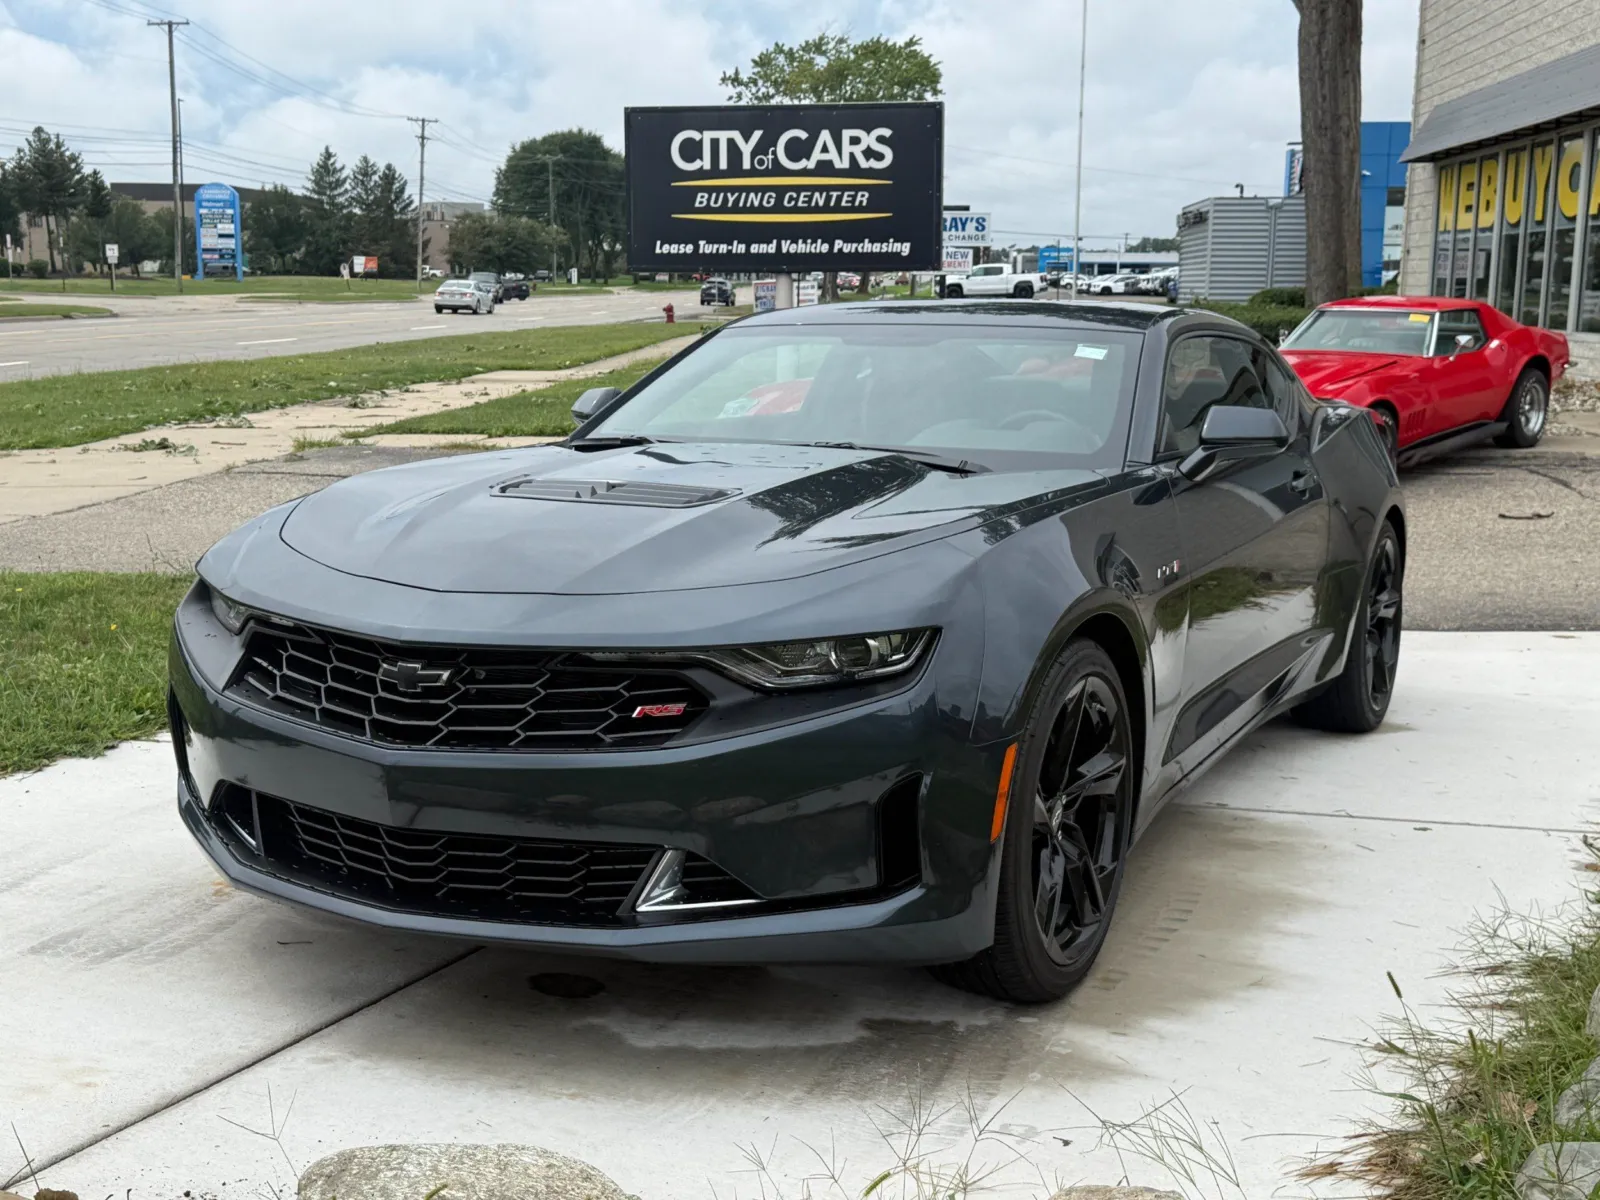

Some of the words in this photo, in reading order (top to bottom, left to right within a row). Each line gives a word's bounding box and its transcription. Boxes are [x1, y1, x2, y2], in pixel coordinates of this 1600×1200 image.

[670, 129, 764, 171] CITY
[754, 147, 775, 170] of
[776, 127, 893, 170] CARS
[694, 191, 776, 208] BUYING
[783, 190, 869, 207] CENTER
[655, 240, 694, 254] Lease
[698, 240, 746, 254] Turn-In
[750, 239, 777, 254] and
[781, 239, 829, 253] Vehicle
[833, 238, 911, 256] Purchasing
[946, 251, 969, 260] NEW
[631, 703, 687, 718] RS
